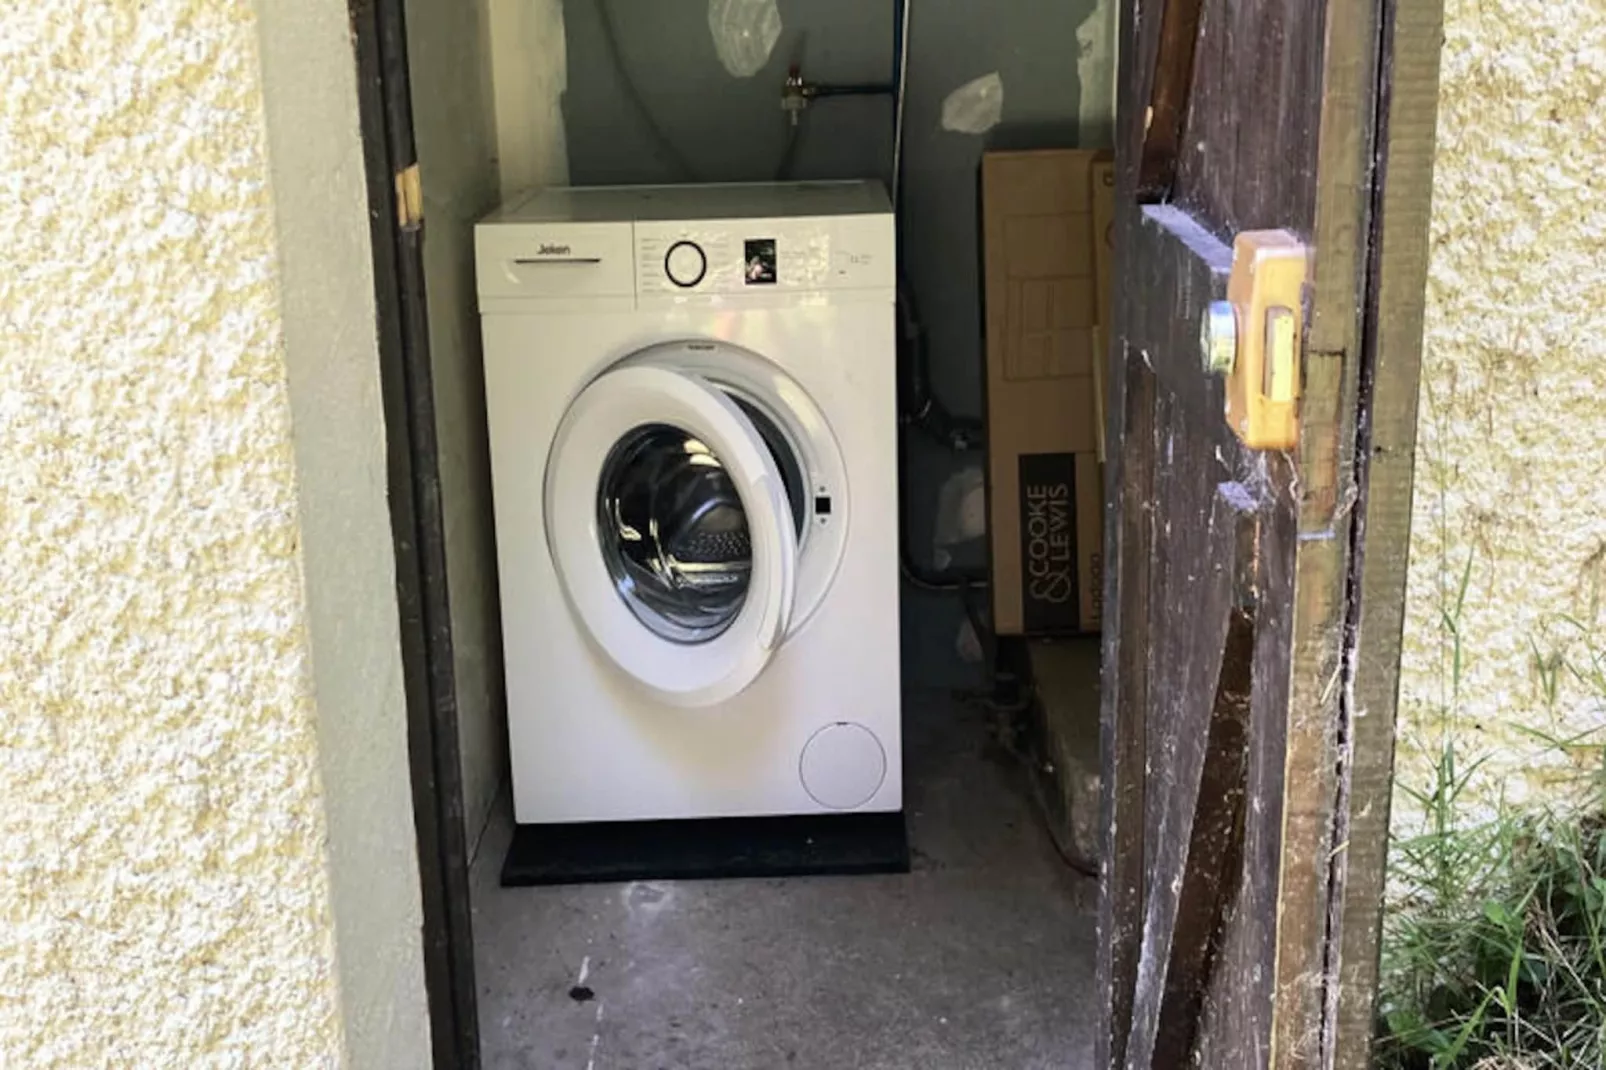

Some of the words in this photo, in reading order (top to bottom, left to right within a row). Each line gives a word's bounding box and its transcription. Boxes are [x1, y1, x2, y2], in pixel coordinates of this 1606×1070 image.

[1027, 485, 1049, 576] COOKE
[1049, 483, 1069, 560] LEWIS
[1030, 565, 1071, 603] &
